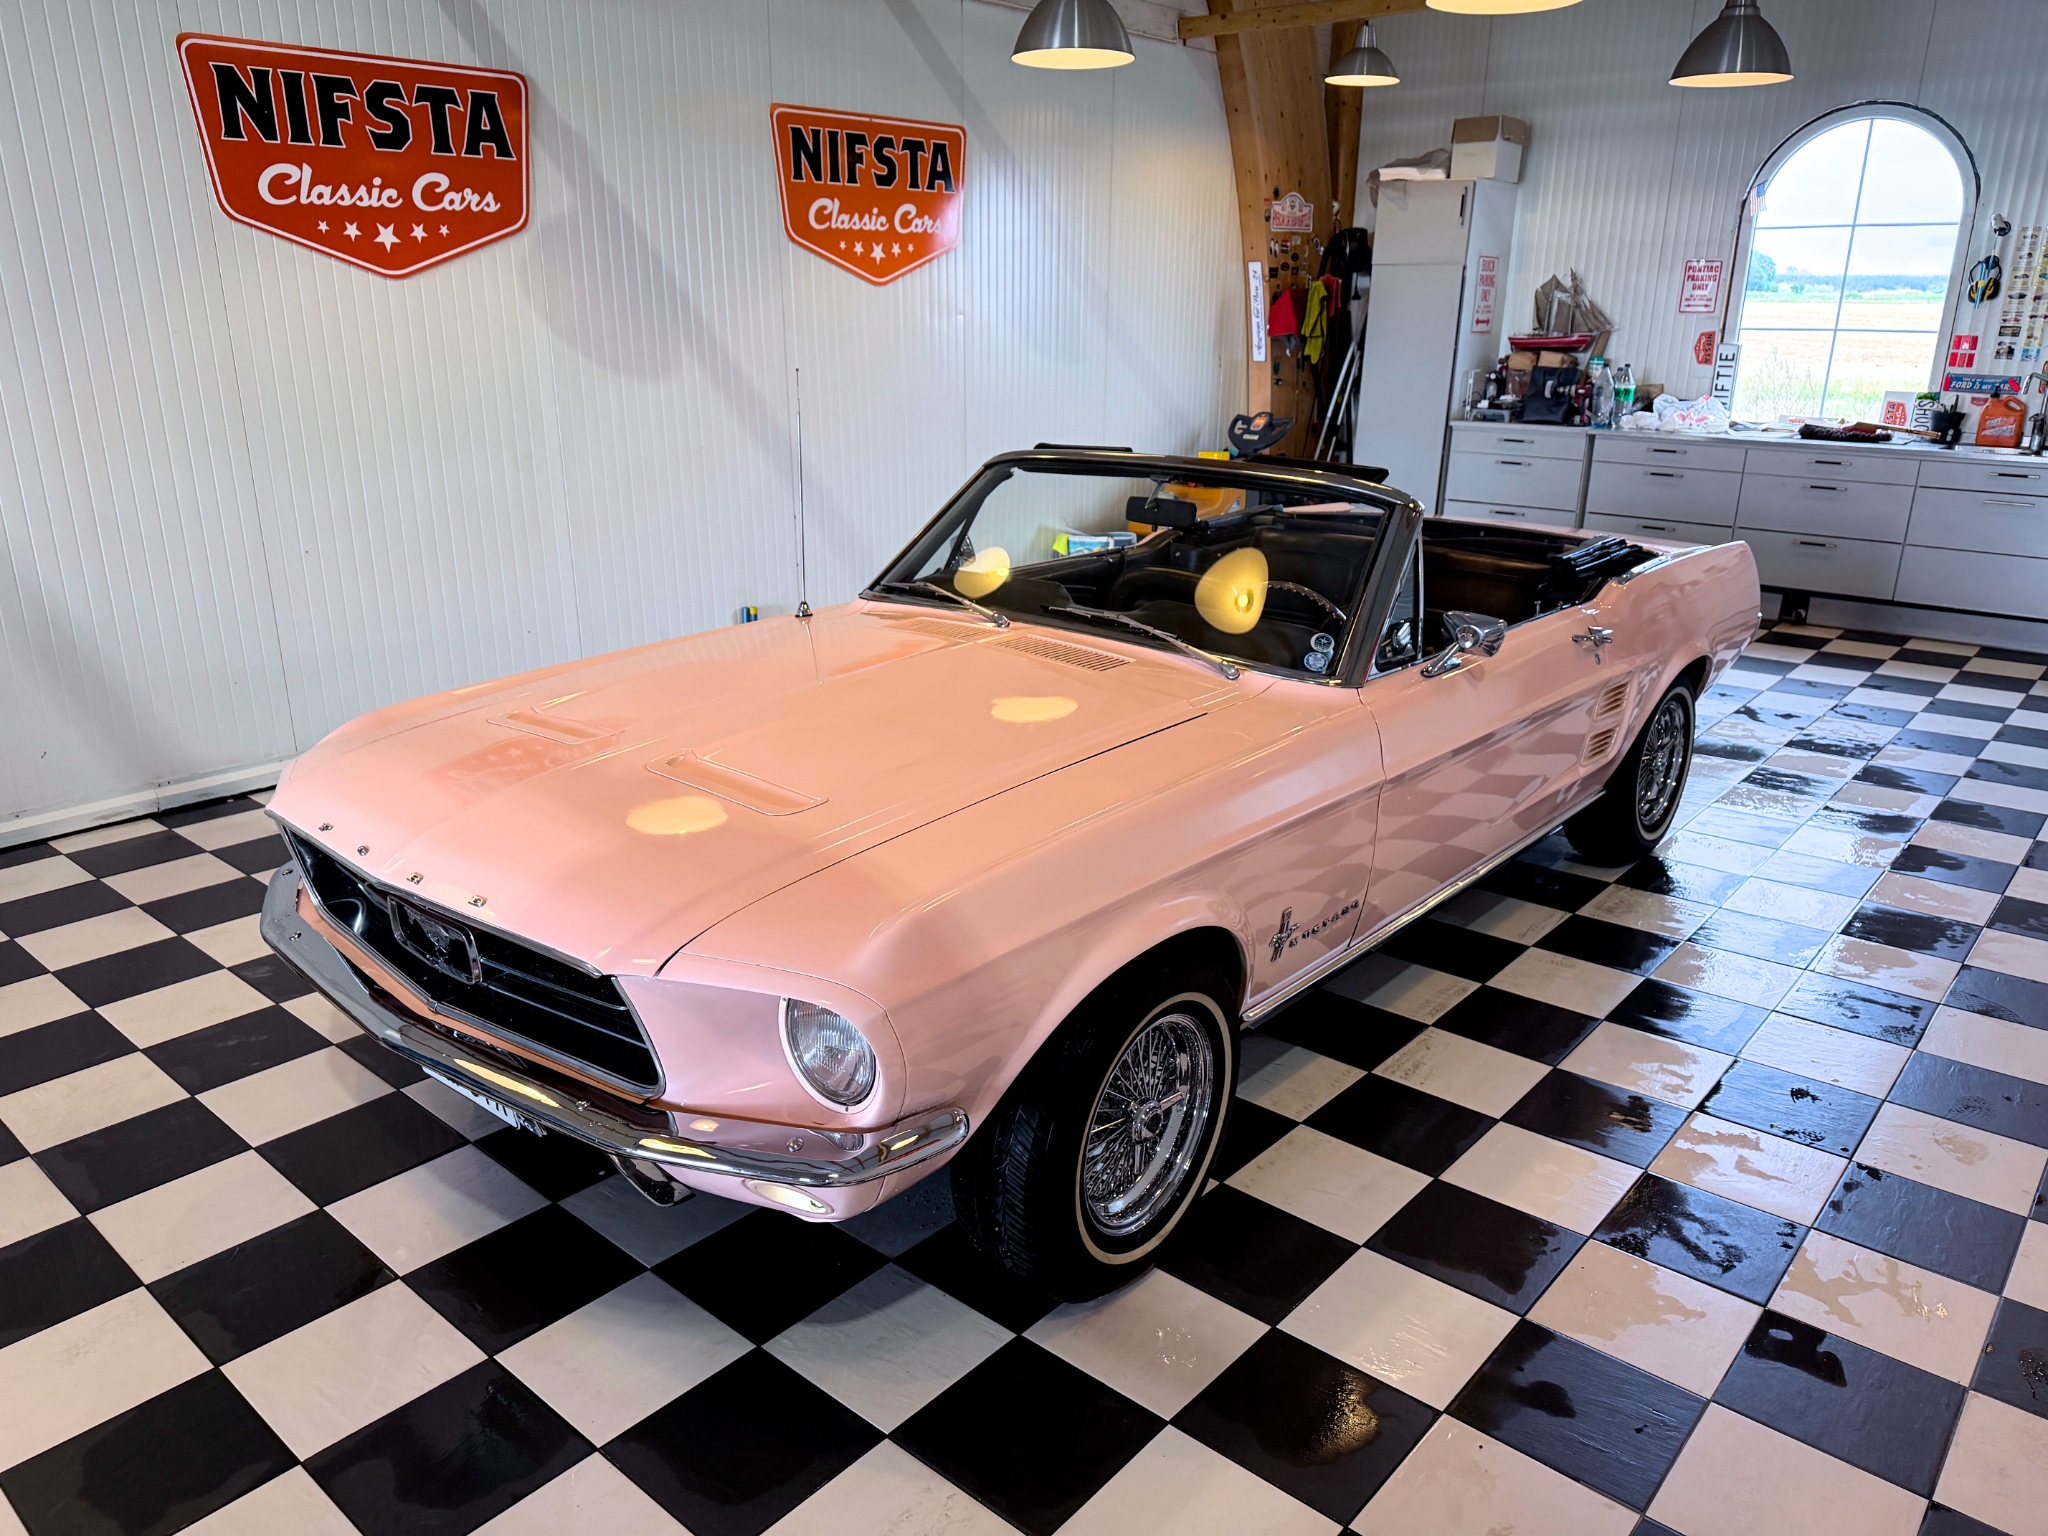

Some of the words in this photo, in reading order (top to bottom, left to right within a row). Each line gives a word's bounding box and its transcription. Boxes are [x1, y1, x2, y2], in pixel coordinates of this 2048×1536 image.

[208, 61, 517, 161] NIFSTA
[788, 125, 956, 194] NIFSTA
[257, 162, 403, 209] Classic
[411, 172, 501, 213] Cars
[808, 197, 889, 232] Classic
[894, 203, 945, 235] Cars
[1686, 274, 1717, 282] PARKING
[1687, 265, 1719, 273] PONTIAC
[1692, 283, 1709, 291] ONLY
[1714, 352, 1736, 410] IFTIE
[1951, 381, 1972, 389] FORD
